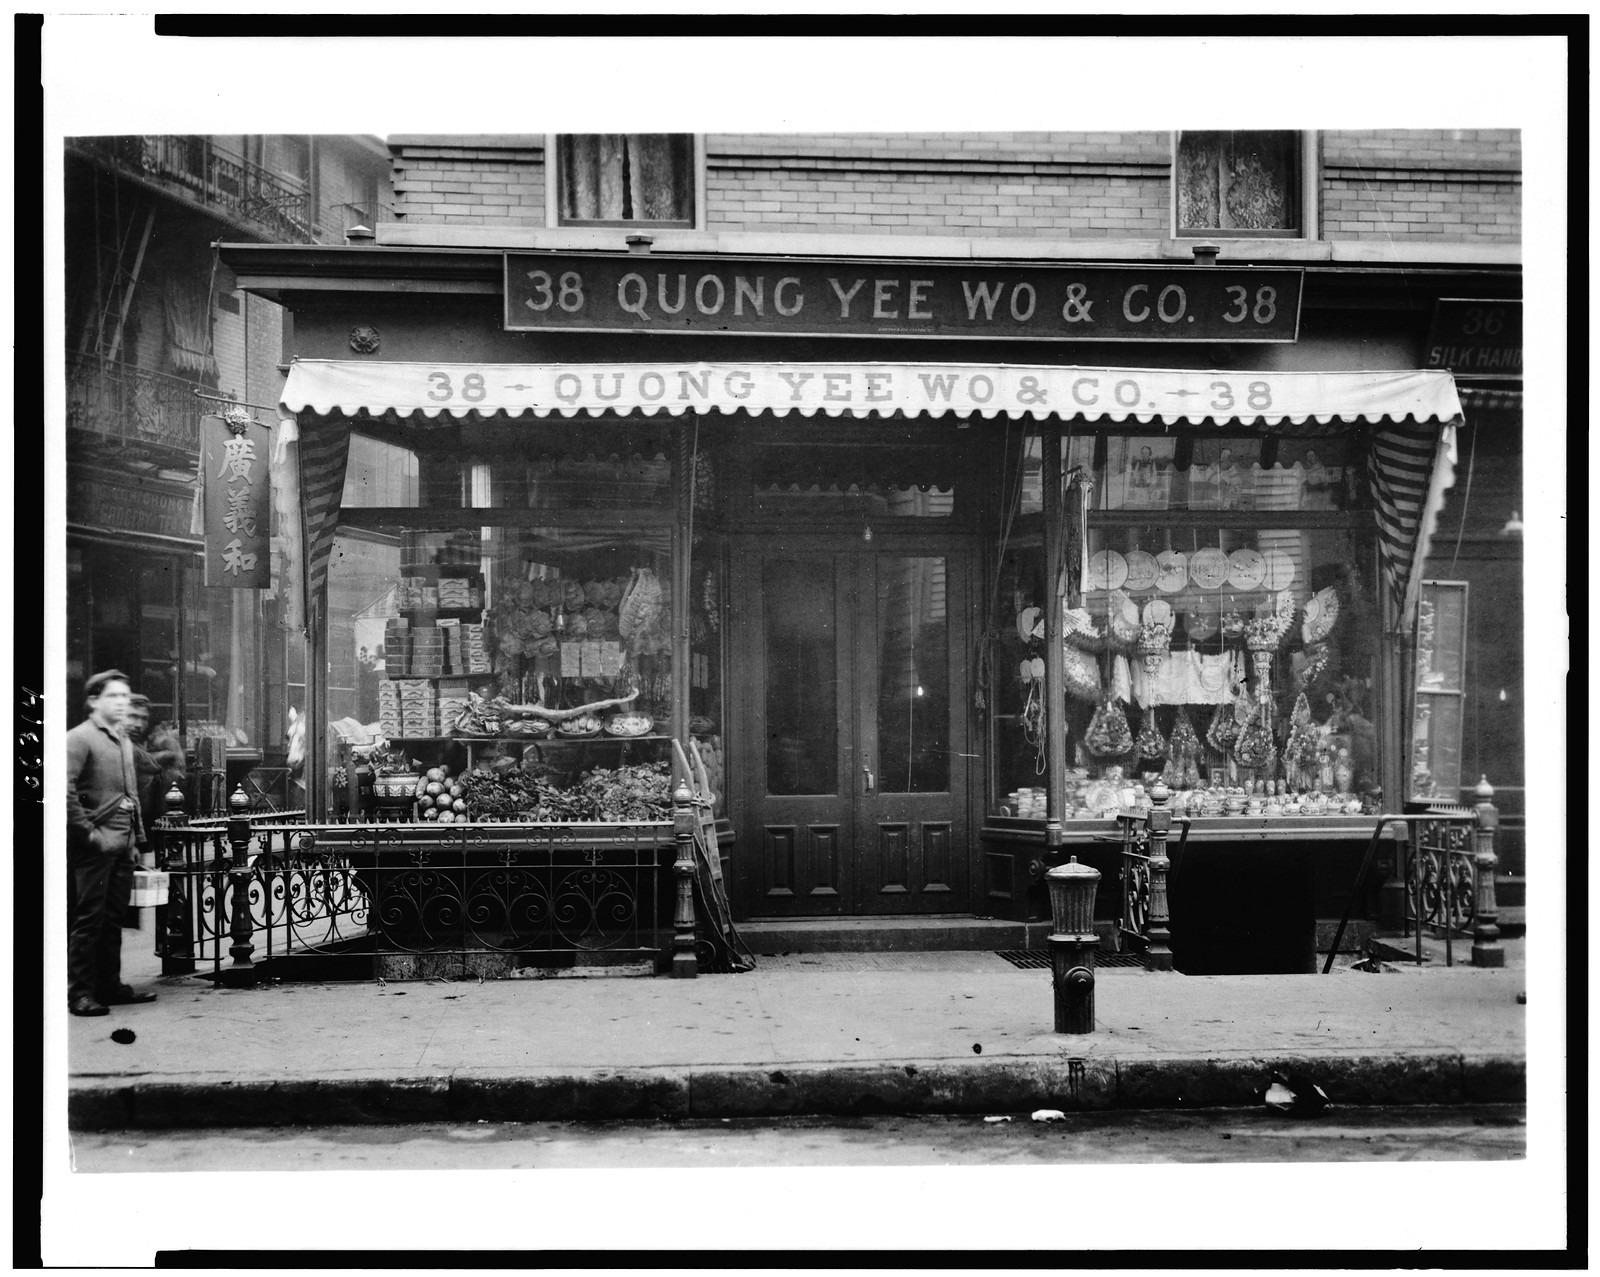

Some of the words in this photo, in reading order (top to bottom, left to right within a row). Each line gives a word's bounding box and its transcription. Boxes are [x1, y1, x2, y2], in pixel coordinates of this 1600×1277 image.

[525, 270, 584, 312] 38
[617, 272, 804, 320] QUONG
[827, 277, 934, 320] YEE
[961, 281, 1037, 321] WO
[1062, 283, 1095, 322] &
[1122, 284, 1194, 323] CO.
[1222, 285, 1277, 324] 38
[1463, 307, 1506, 334] 36
[1428, 346, 1474, 366] SILK
[427, 371, 487, 402] 38
[554, 370, 755, 405] QUONG
[778, 371, 893, 402] YEE
[917, 373, 994, 404] WO
[1016, 375, 1048, 405] &
[1071, 377, 1156, 408] CO.
[1210, 381, 1272, 410] 38
[217, 433, 257, 577] 廣義和
